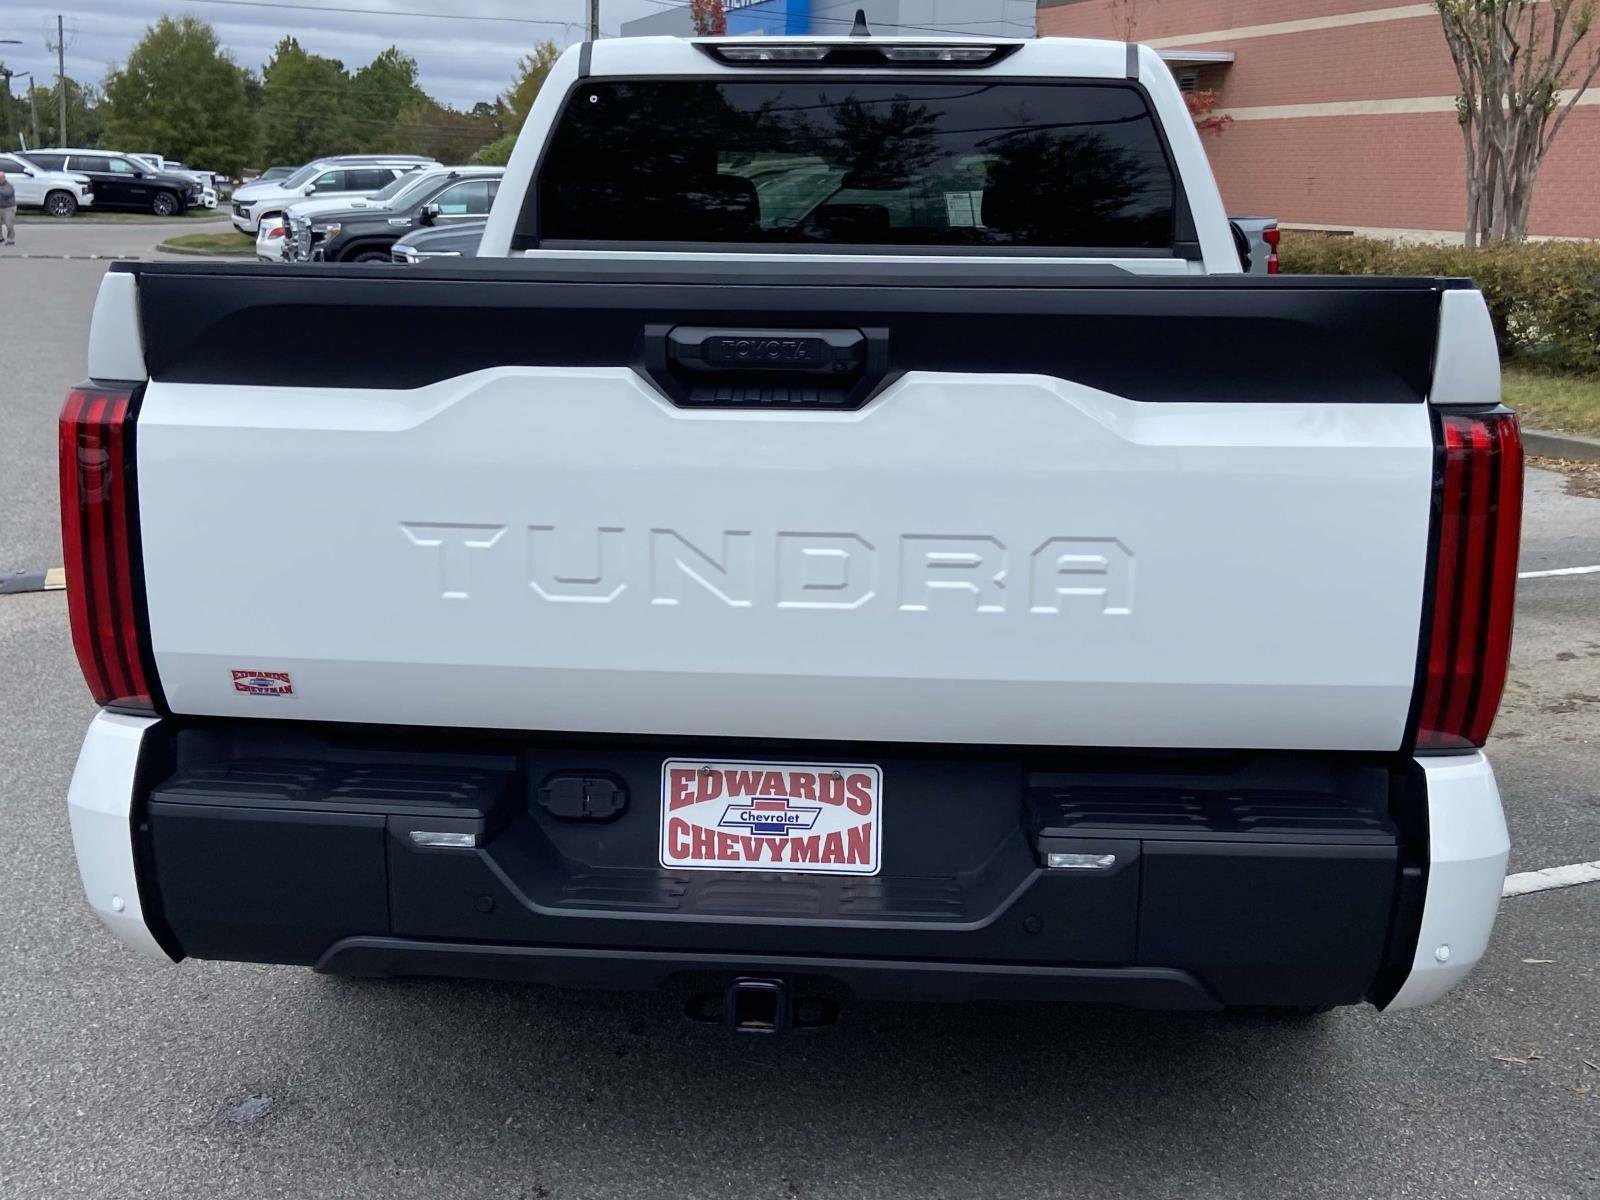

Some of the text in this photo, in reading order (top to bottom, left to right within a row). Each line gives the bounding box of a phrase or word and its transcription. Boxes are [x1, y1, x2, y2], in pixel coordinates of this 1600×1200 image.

[721, 340, 812, 360] TOYOTA
[399, 521, 1135, 615] TUNDRA
[231, 670, 290, 684] EDWARDS
[669, 768, 872, 816] EDWARDS
[740, 810, 800, 824] Chevrolet
[668, 816, 872, 865] CHEVYMAN
